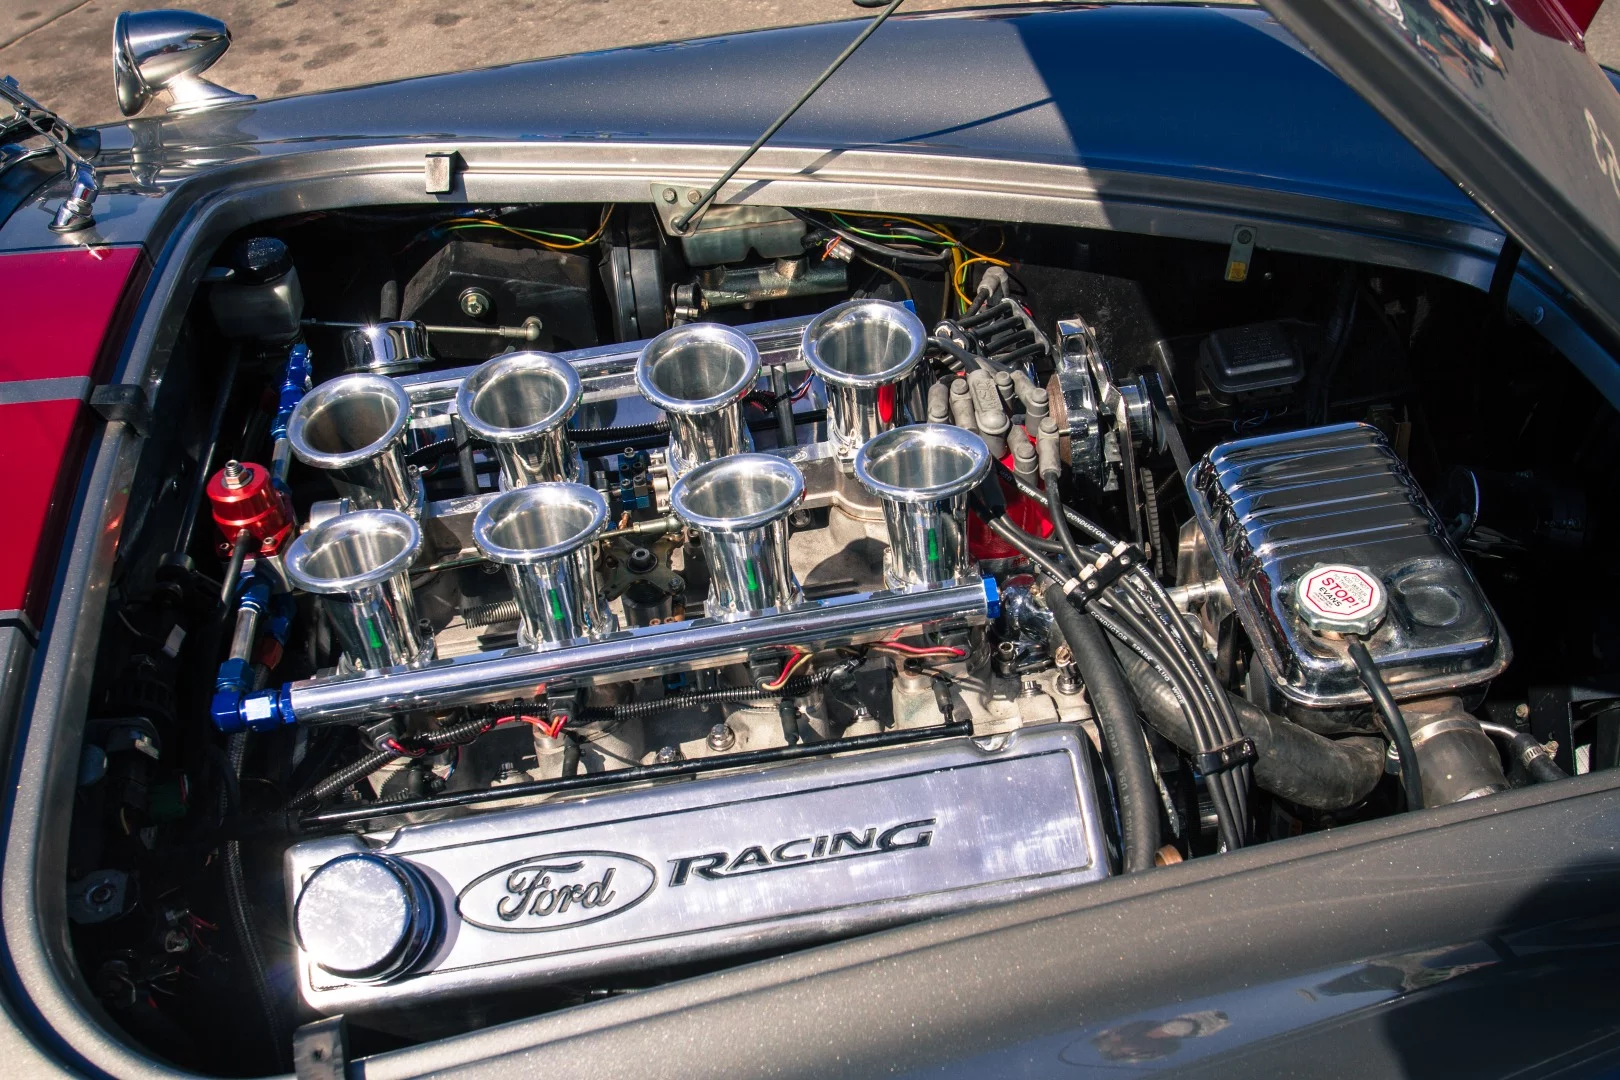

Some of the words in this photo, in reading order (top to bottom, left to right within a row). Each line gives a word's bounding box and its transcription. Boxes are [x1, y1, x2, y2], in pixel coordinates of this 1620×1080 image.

[1066, 512, 1106, 538] CONDUCTOR
[1319, 587, 1342, 607] EVANS
[1322, 578, 1359, 608] STOP!
[1090, 611, 1128, 641] CONDUCTOR
[1131, 643, 1153, 662] SPARK
[1155, 664, 1171, 682] PLUG
[1171, 686, 1186, 704] WIRE
[1118, 768, 1129, 791] USA
[498, 860, 617, 922] Ford
[668, 818, 936, 888] RACING
